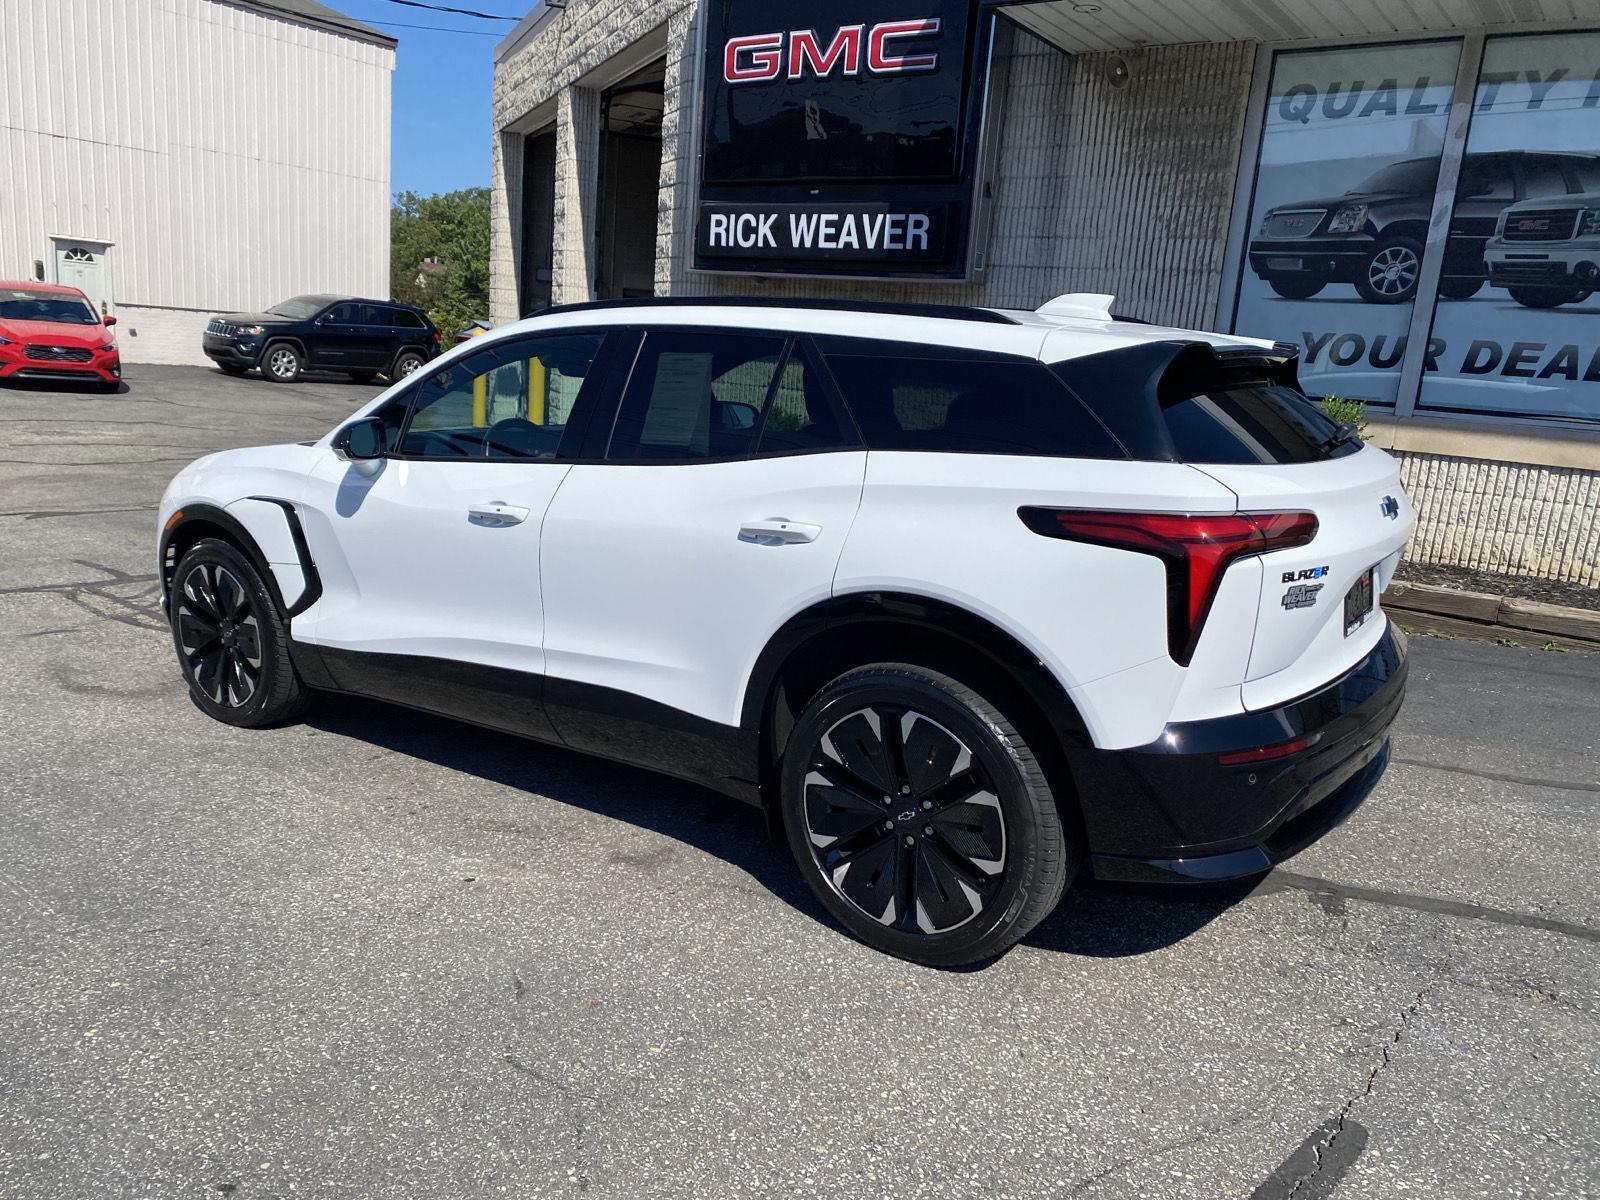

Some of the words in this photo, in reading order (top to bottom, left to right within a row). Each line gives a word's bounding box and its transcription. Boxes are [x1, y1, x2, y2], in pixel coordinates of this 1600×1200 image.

[723, 18, 941, 83] GMC
[1278, 68, 1570, 124] QUALTY
[709, 213, 778, 248] RICK
[789, 213, 930, 250] WEAVER
